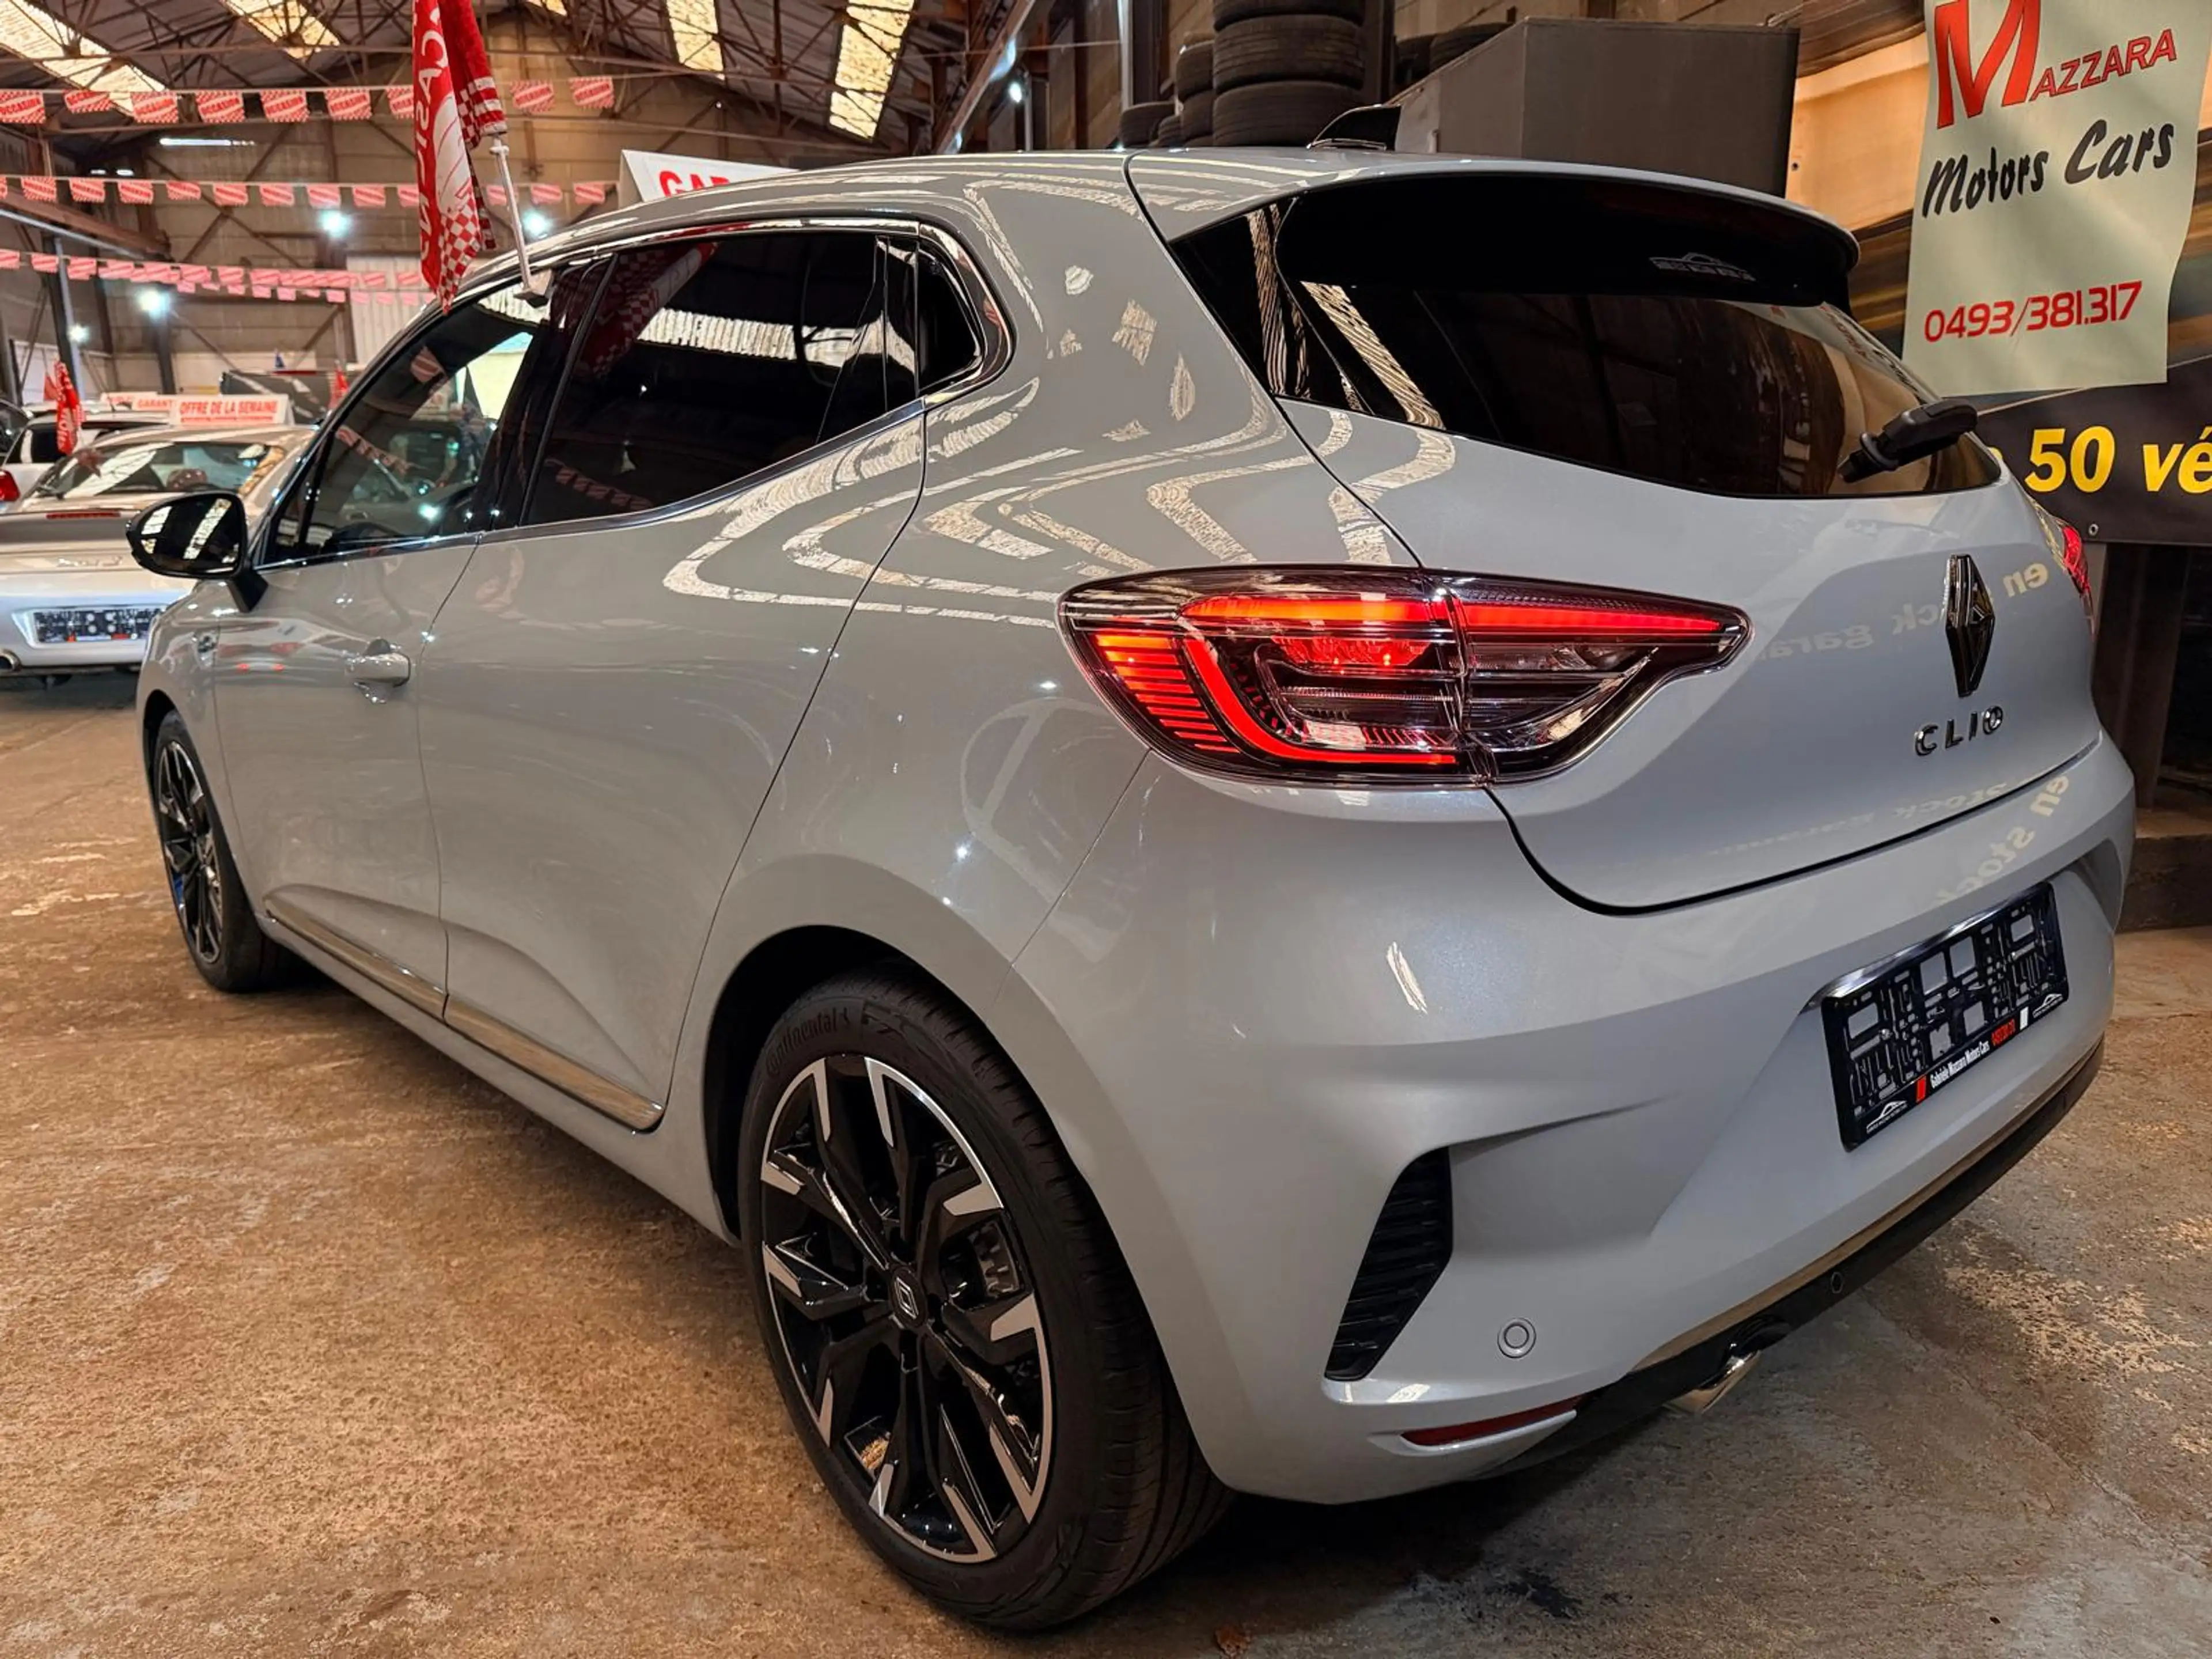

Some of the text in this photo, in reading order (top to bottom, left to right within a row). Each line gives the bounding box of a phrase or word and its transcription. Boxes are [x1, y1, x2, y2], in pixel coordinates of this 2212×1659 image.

[1935, 0, 2177, 129] MAZZARA
[1922, 119, 2174, 218] Motors Cars
[2024, 426, 2116, 493] 50
[1914, 706, 2003, 756] CLIO
